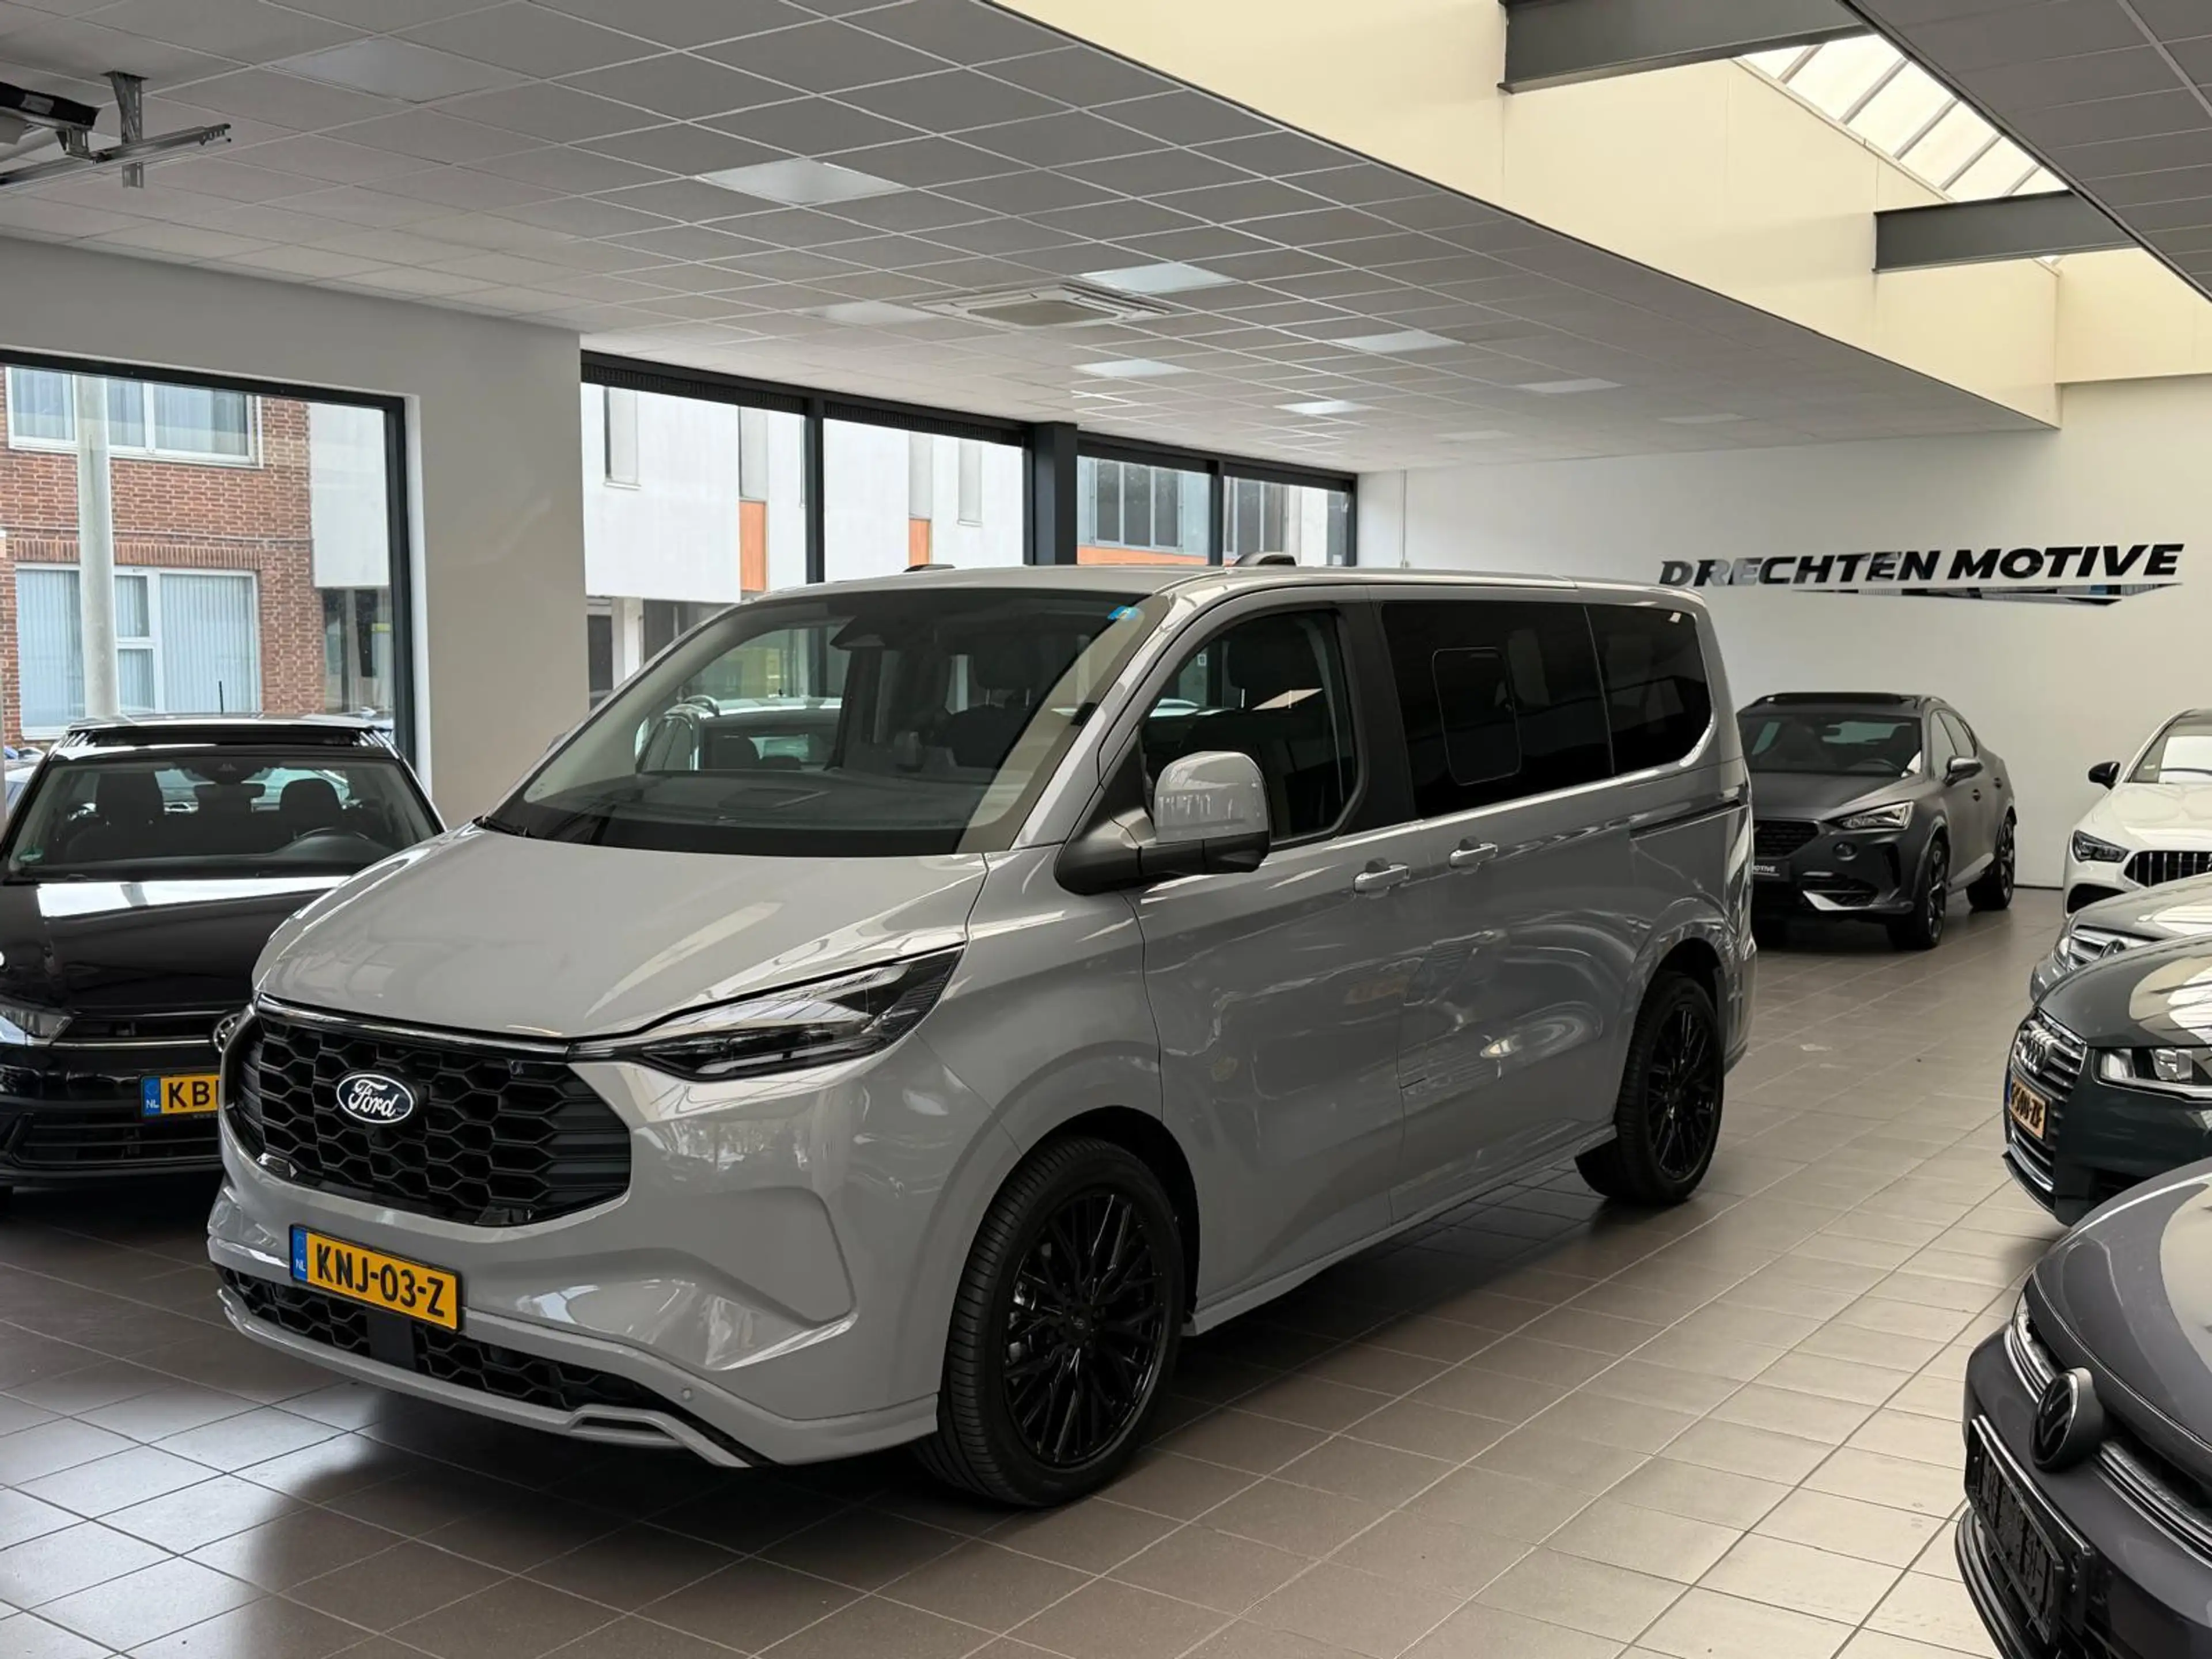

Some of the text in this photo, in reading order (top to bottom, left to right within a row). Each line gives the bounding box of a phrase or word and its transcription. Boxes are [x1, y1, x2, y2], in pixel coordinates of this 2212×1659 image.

[1660, 543, 2185, 587] DRECHTEN MOTIVE
[146, 1099, 160, 1109] NL
[168, 1080, 219, 1109] KB
[348, 1079, 399, 1118] Ford
[295, 1258, 306, 1272] NL
[316, 1243, 445, 1318] KNJ-03-Z
